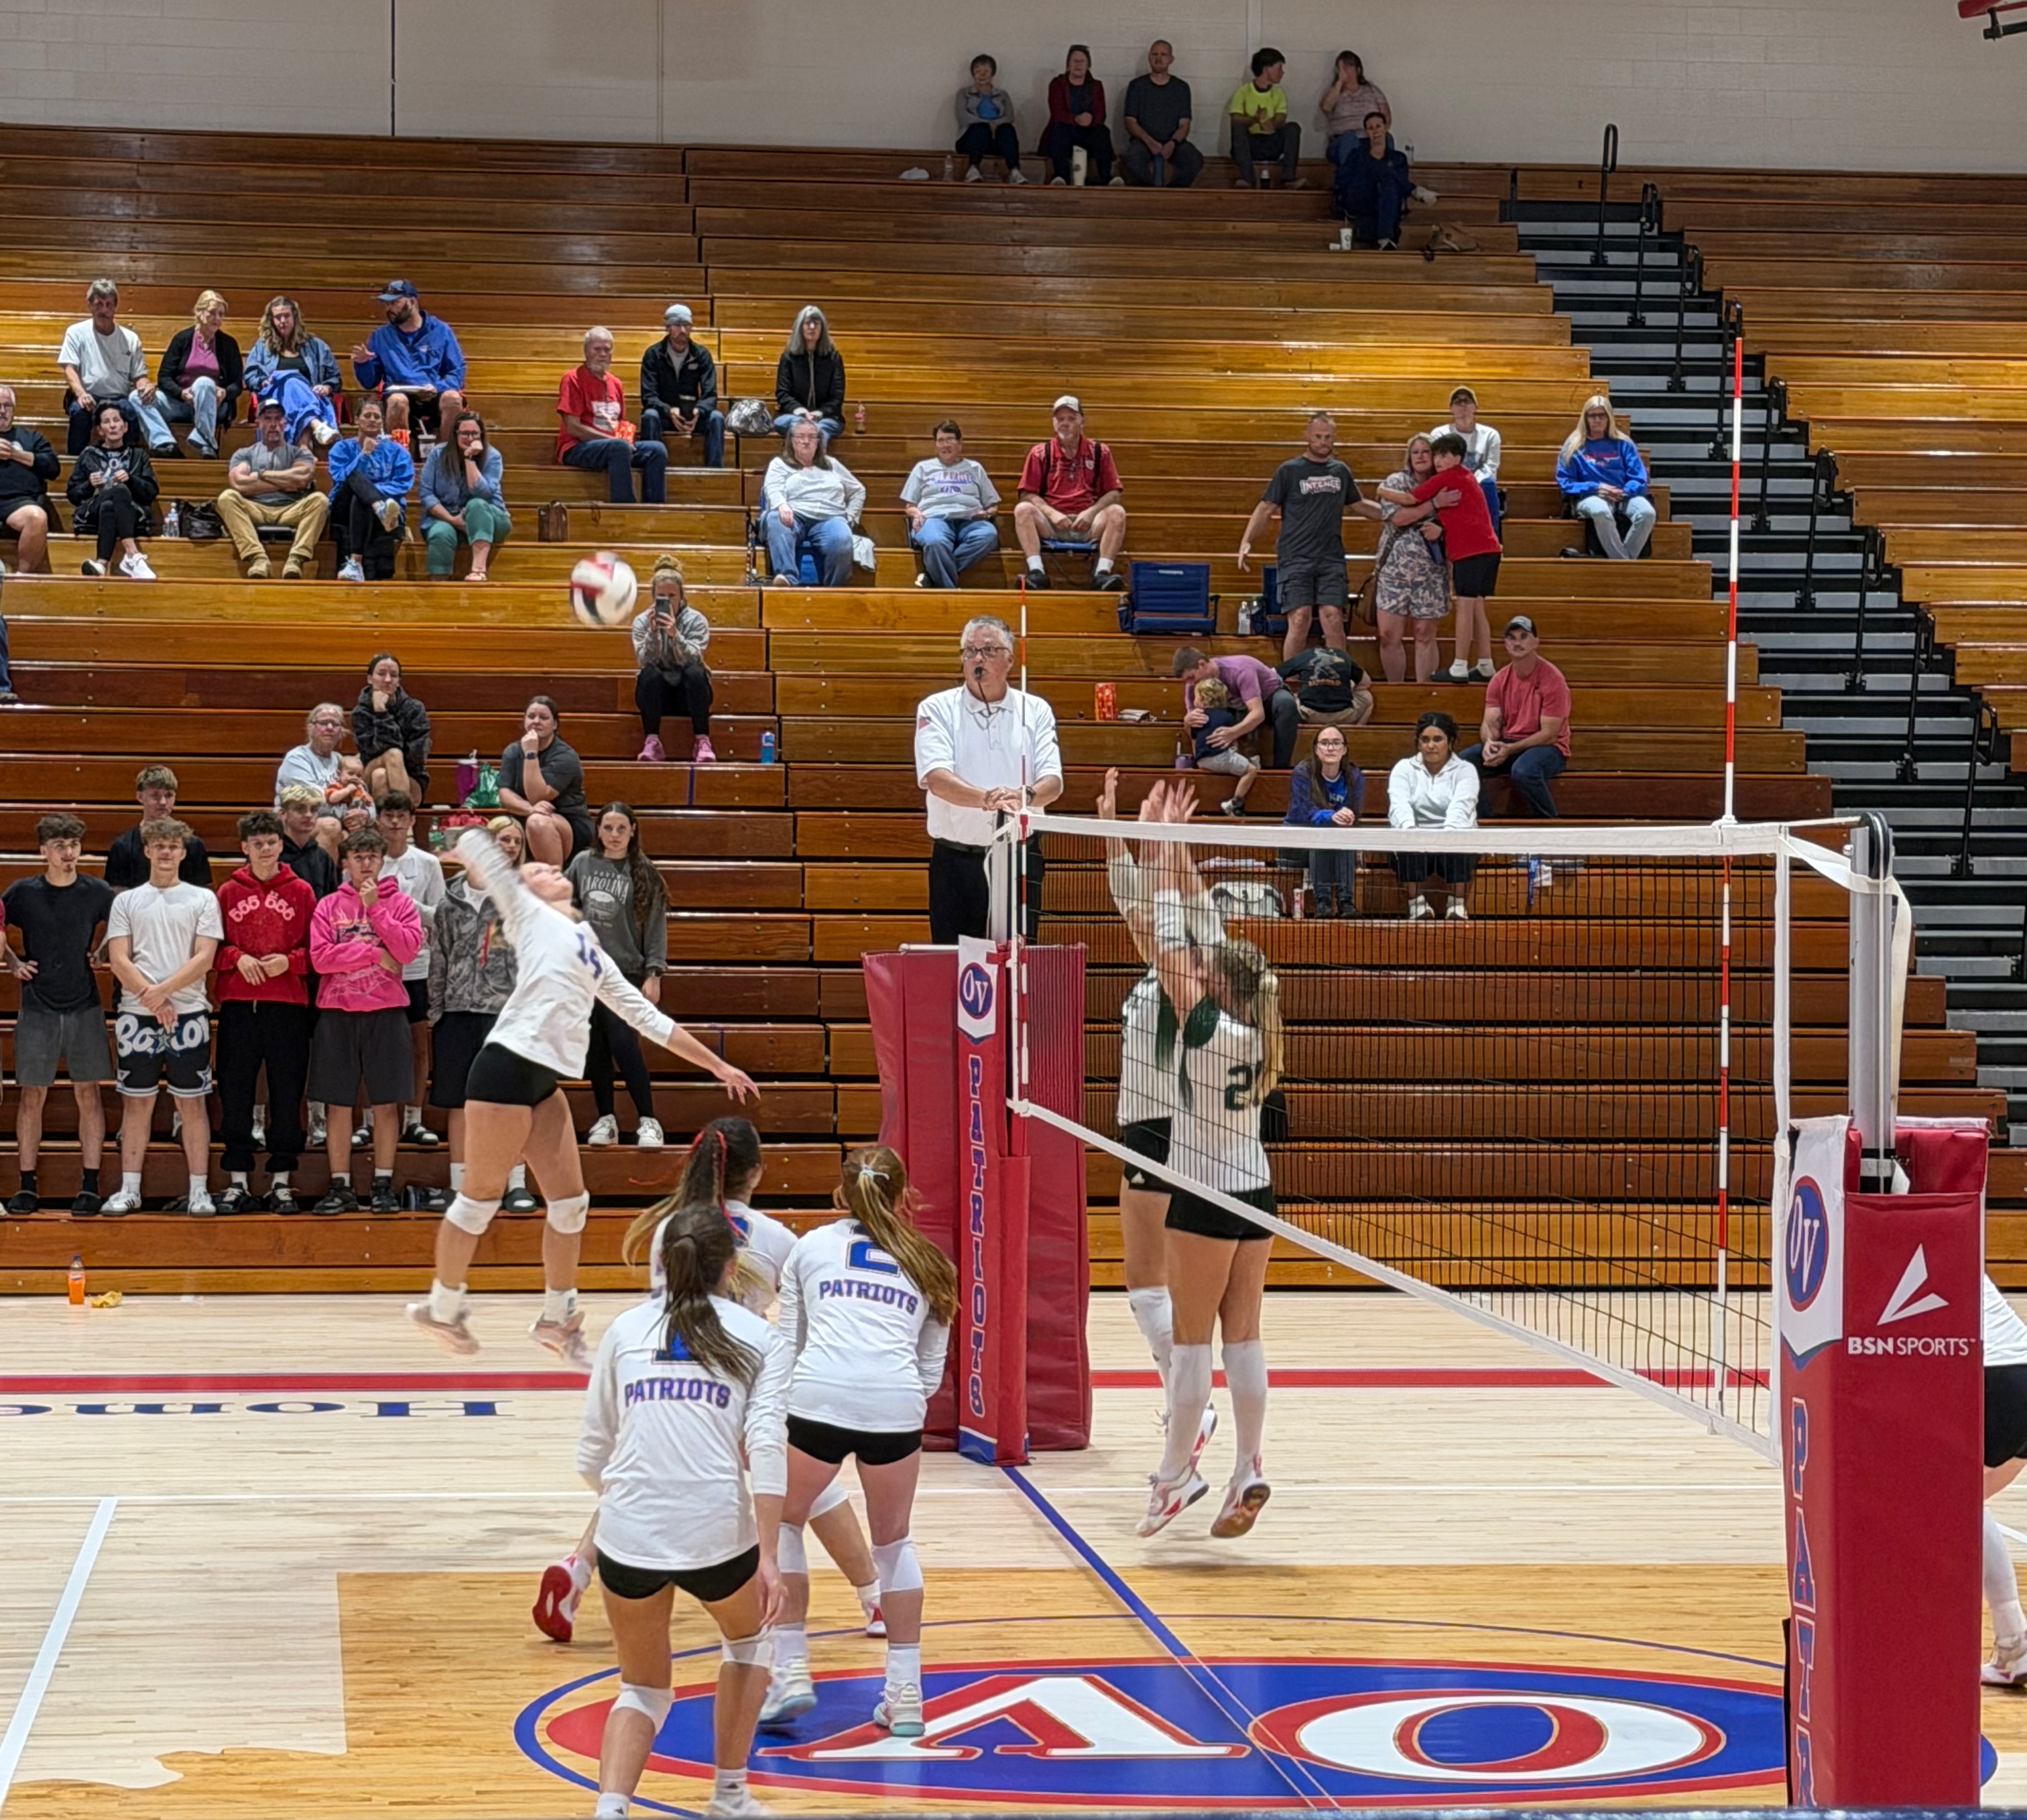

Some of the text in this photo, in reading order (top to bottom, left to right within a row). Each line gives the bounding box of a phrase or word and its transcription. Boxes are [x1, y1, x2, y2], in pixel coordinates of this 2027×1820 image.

[963, 969, 989, 1013] OV
[969, 1054, 986, 1417] PATRIOTS
[819, 1278, 919, 1316] PATRIOTS
[624, 1377, 731, 1410] PATRIOTS
